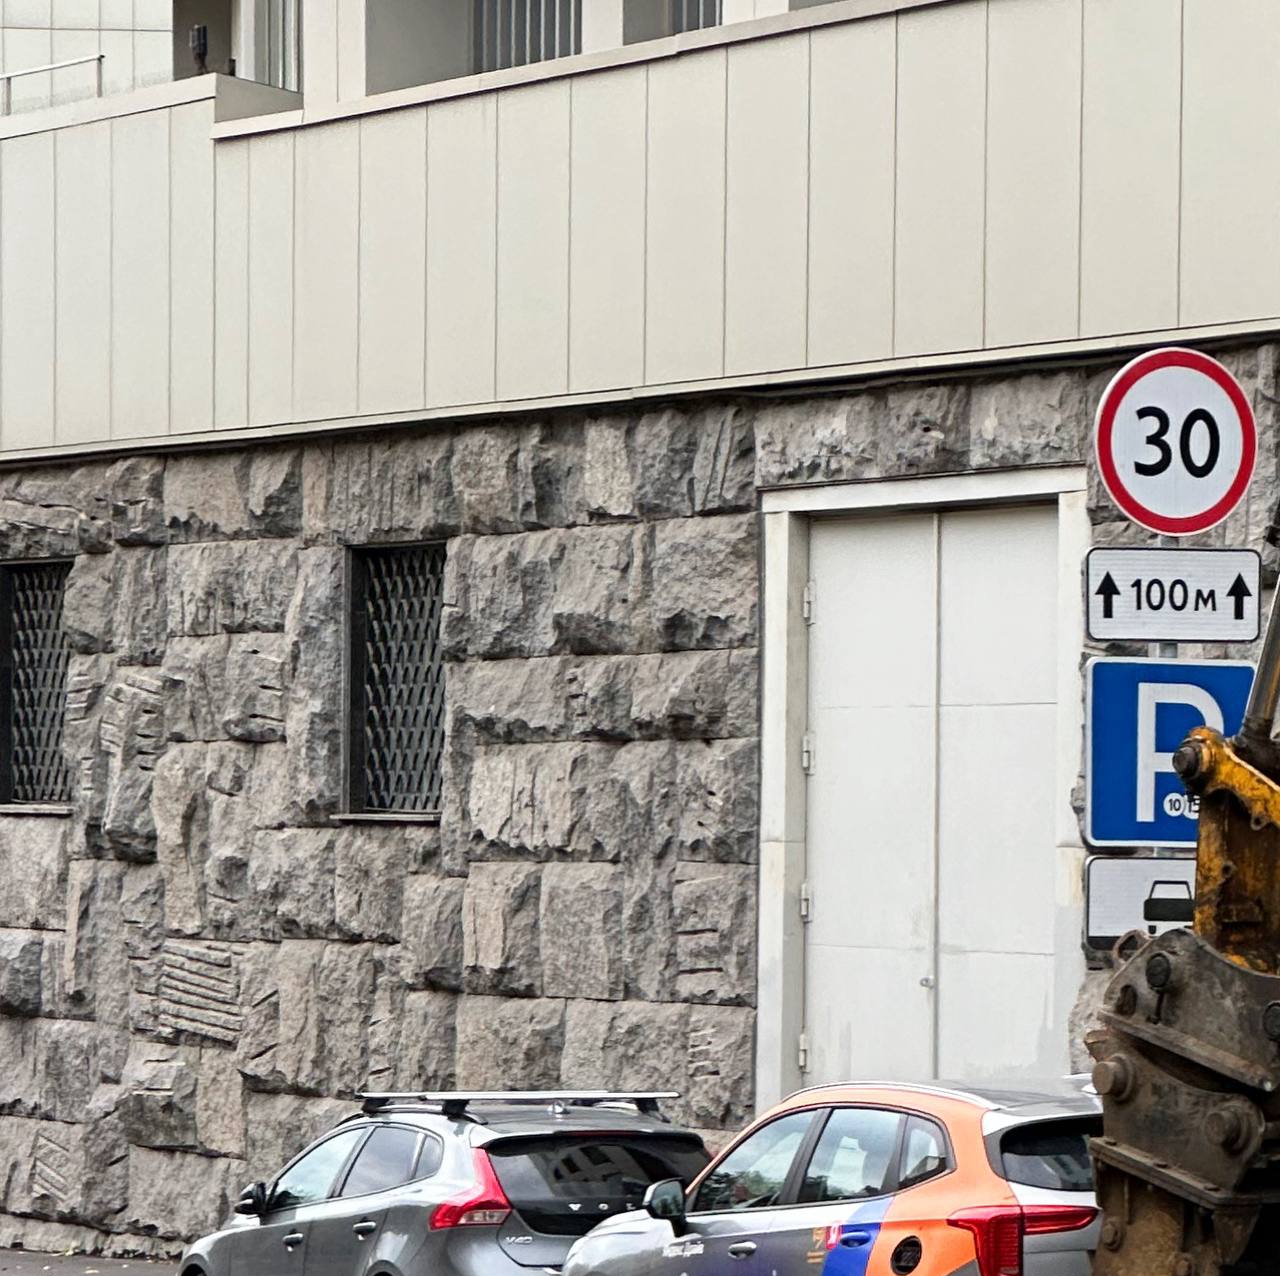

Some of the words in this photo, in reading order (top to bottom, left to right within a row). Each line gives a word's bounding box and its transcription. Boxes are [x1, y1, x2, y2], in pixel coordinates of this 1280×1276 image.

[1133, 406, 1221, 478] 30
[1136, 683, 1225, 822] P
[1168, 798, 1182, 812] 10
